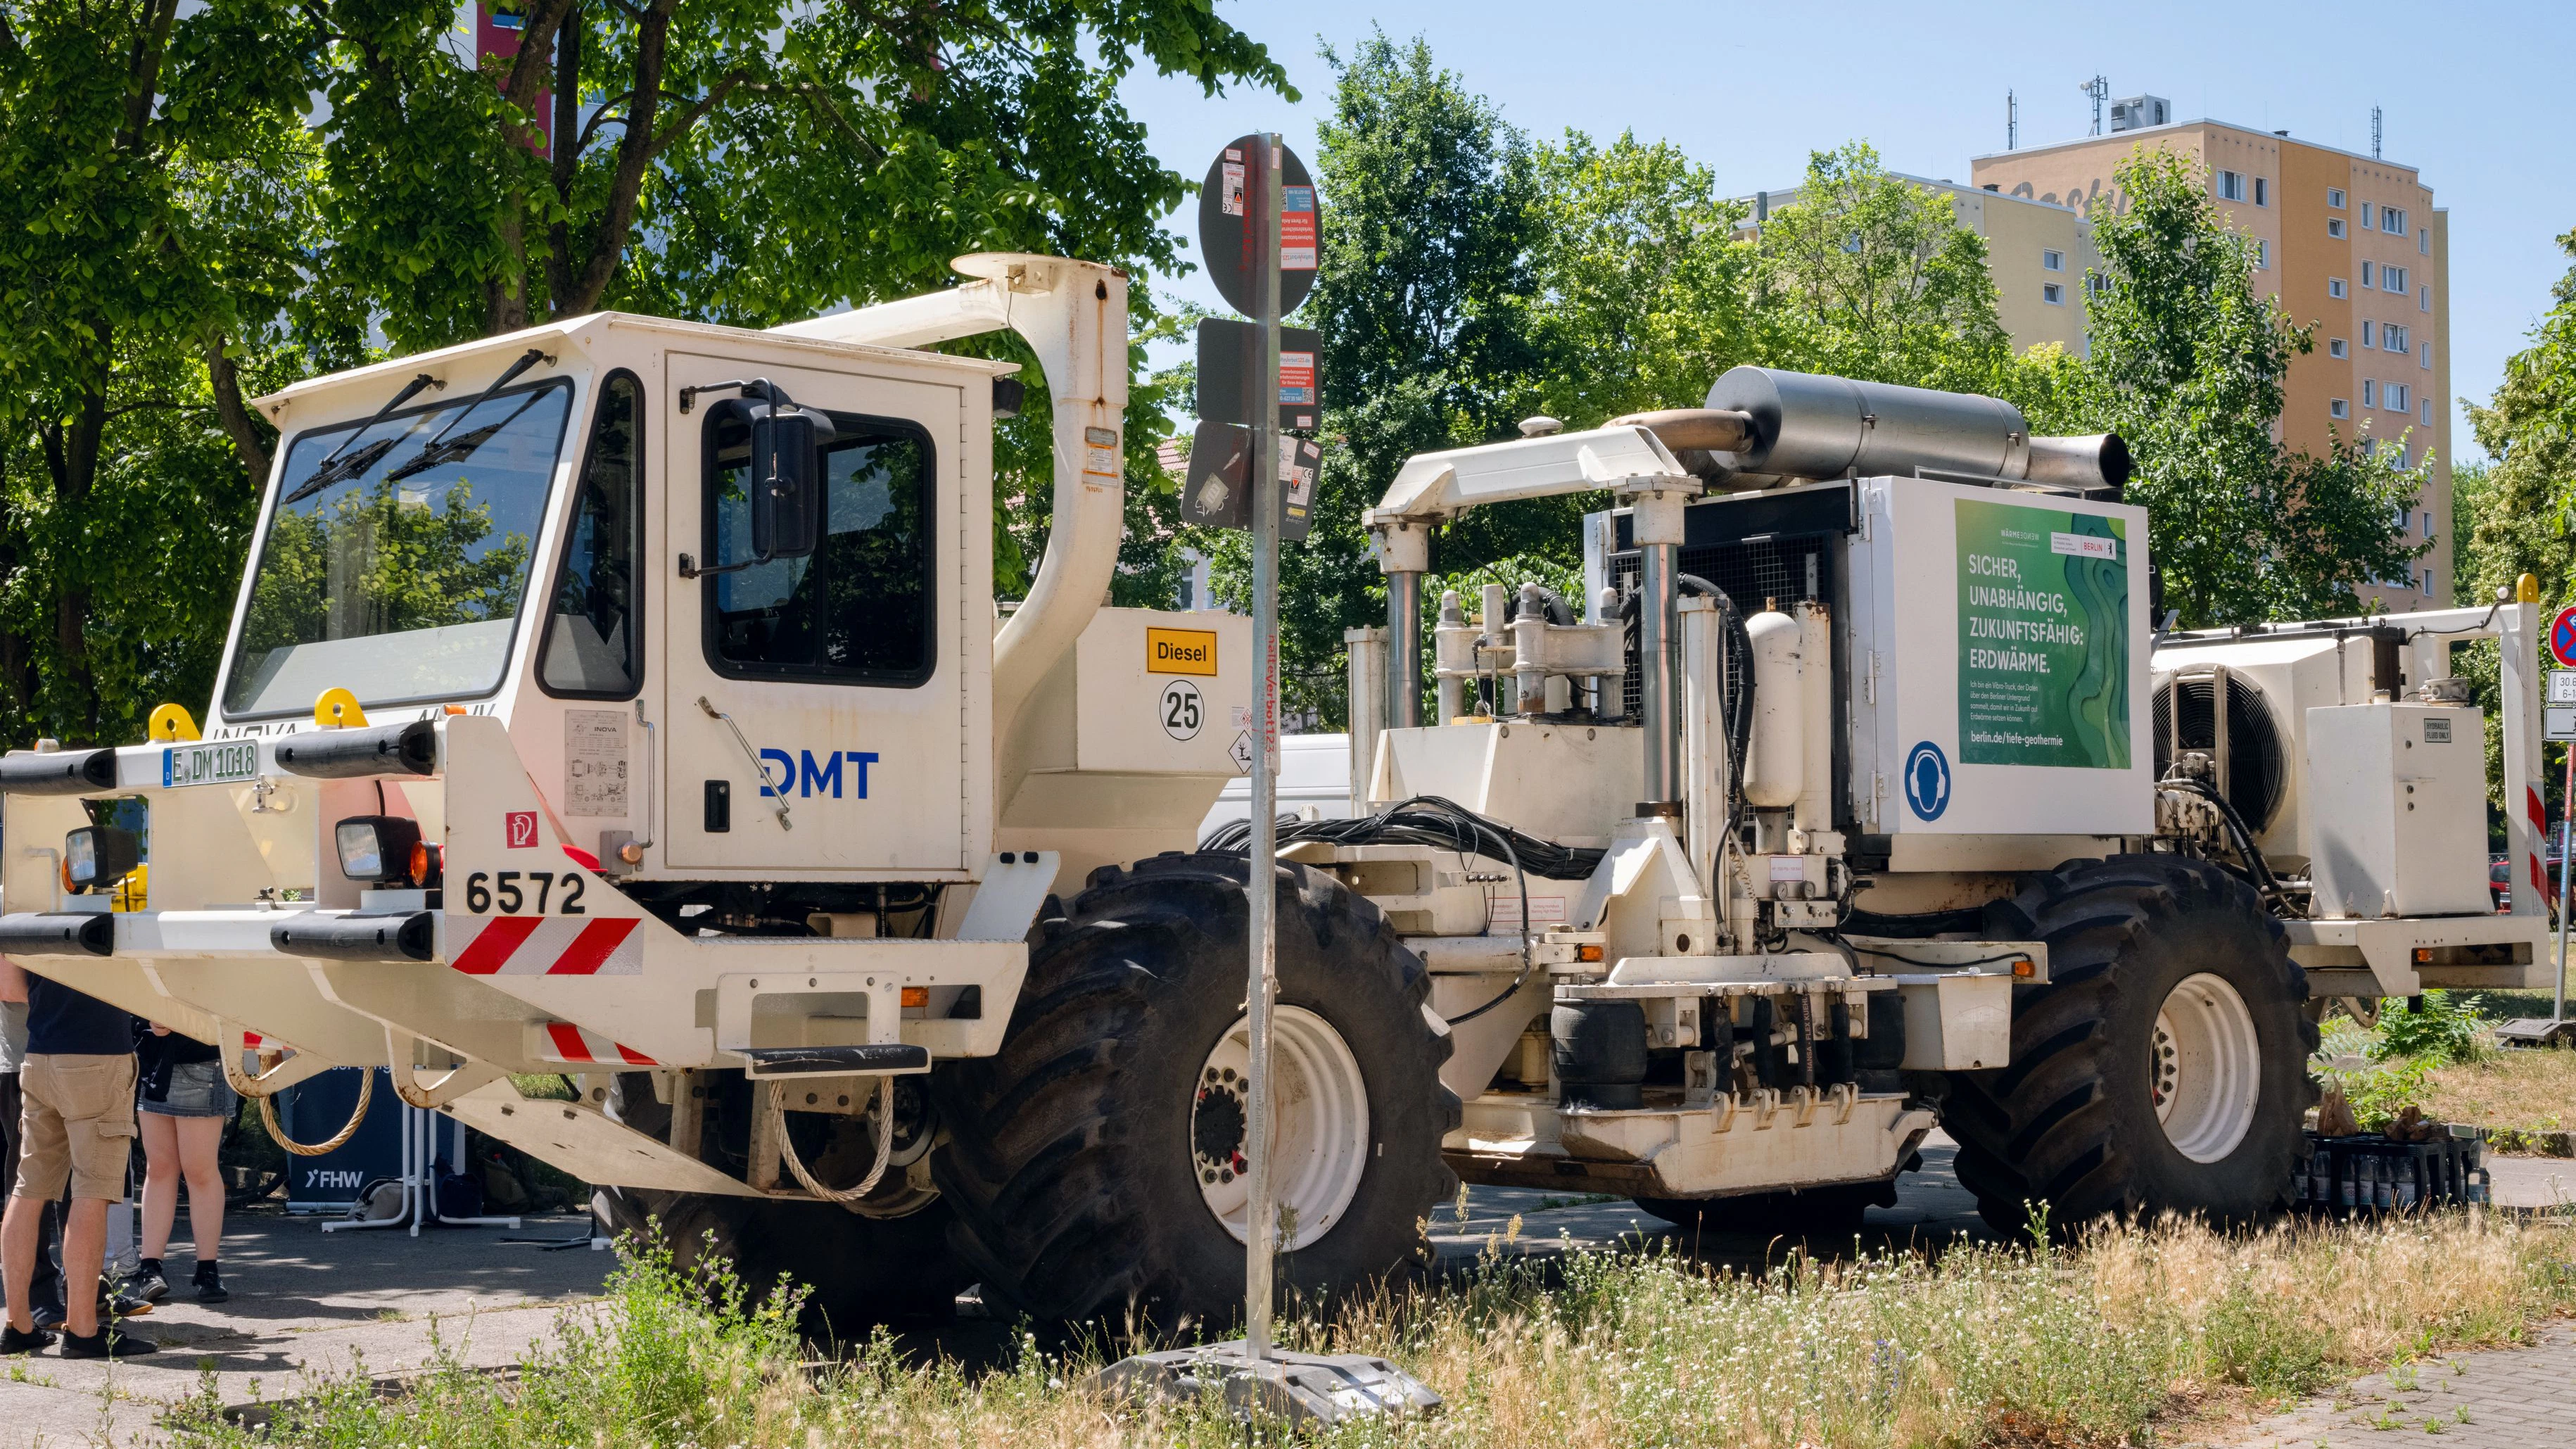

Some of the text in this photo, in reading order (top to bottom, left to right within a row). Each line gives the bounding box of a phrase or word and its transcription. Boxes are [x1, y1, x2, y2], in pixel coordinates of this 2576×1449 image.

[2083, 542, 2102, 552] BERLIN
[1969, 554, 2022, 583] SICHER,
[1969, 585, 2067, 618] UNABHÄNGIG,
[1969, 616, 2083, 645] ZUKUNFTSFÄHIG:
[1157, 642, 1207, 662] Diesel
[1970, 646, 2050, 673] ERDWÄRME.
[1970, 690, 1980, 699] über
[1990, 692, 2006, 700] Berliner
[2006, 693, 2031, 703] Untergrund
[1992, 681, 2017, 691] Vibro-Truck,
[1167, 692, 1199, 729] 25
[1970, 712, 1992, 721] Erdwärme
[2006, 714, 2024, 722] können.
[1990, 702, 2003, 711] damit
[2015, 704, 2031, 712] Zukunft
[1971, 730, 2063, 747] berlin.de/tiefe-geothermie
[173, 751, 182, 781] E
[759, 748, 880, 800] DMT
[466, 871, 585, 914] 6572
[320, 1171, 363, 1188] FHW
